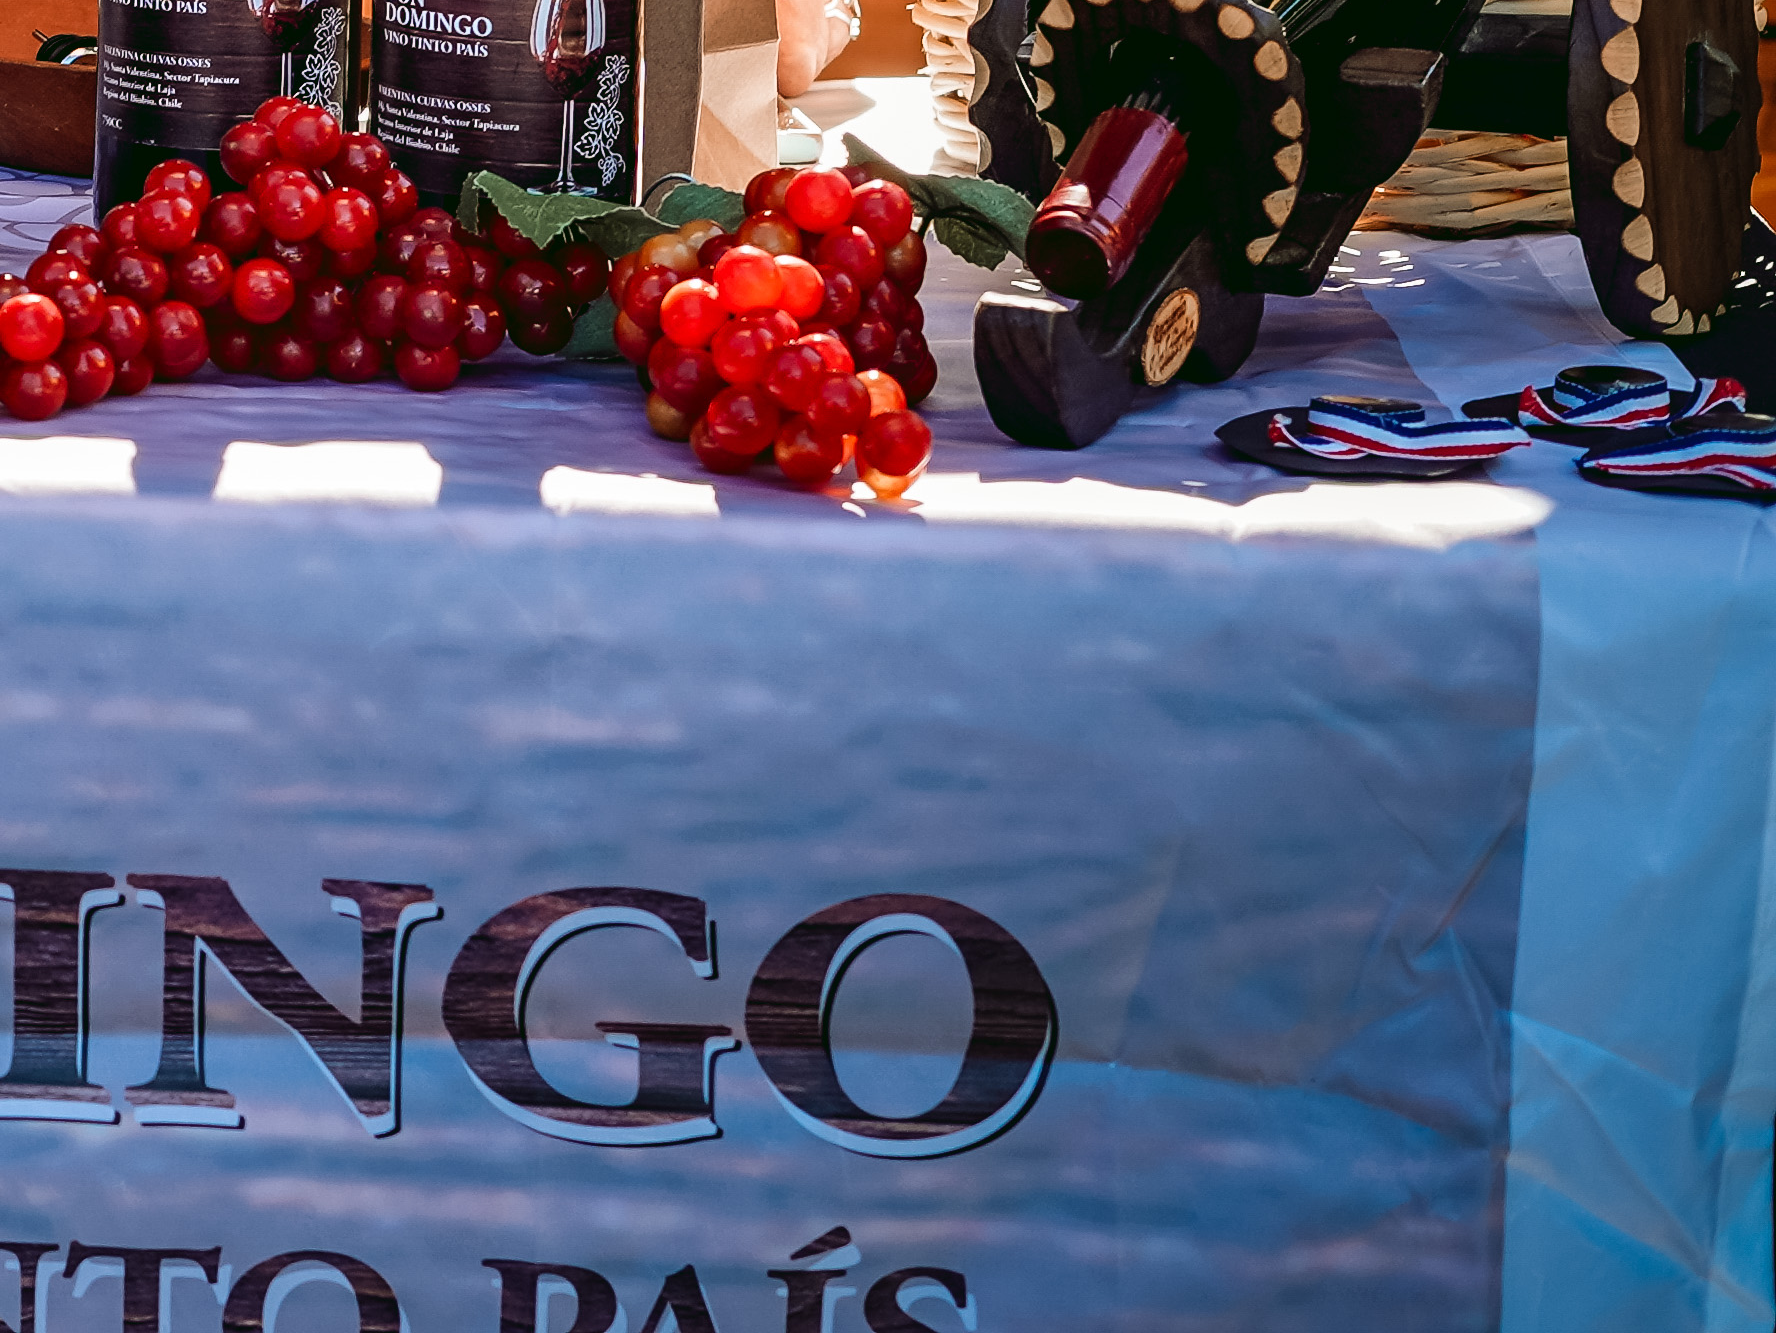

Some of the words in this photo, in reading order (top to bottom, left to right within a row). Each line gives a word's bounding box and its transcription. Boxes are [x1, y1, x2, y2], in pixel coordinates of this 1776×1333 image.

[385, 2, 493, 37] DOMINGO
[384, 28, 408, 46] VINO
[409, 35, 453, 53] TINTO
[456, 41, 489, 58] PAÍS
[177, 57, 211, 68] OSSES
[193, 73, 240, 87] Tapiacura
[416, 95, 455, 110] CUEVAS
[456, 101, 492, 113] OSSES
[472, 118, 520, 132] Tapiacura
